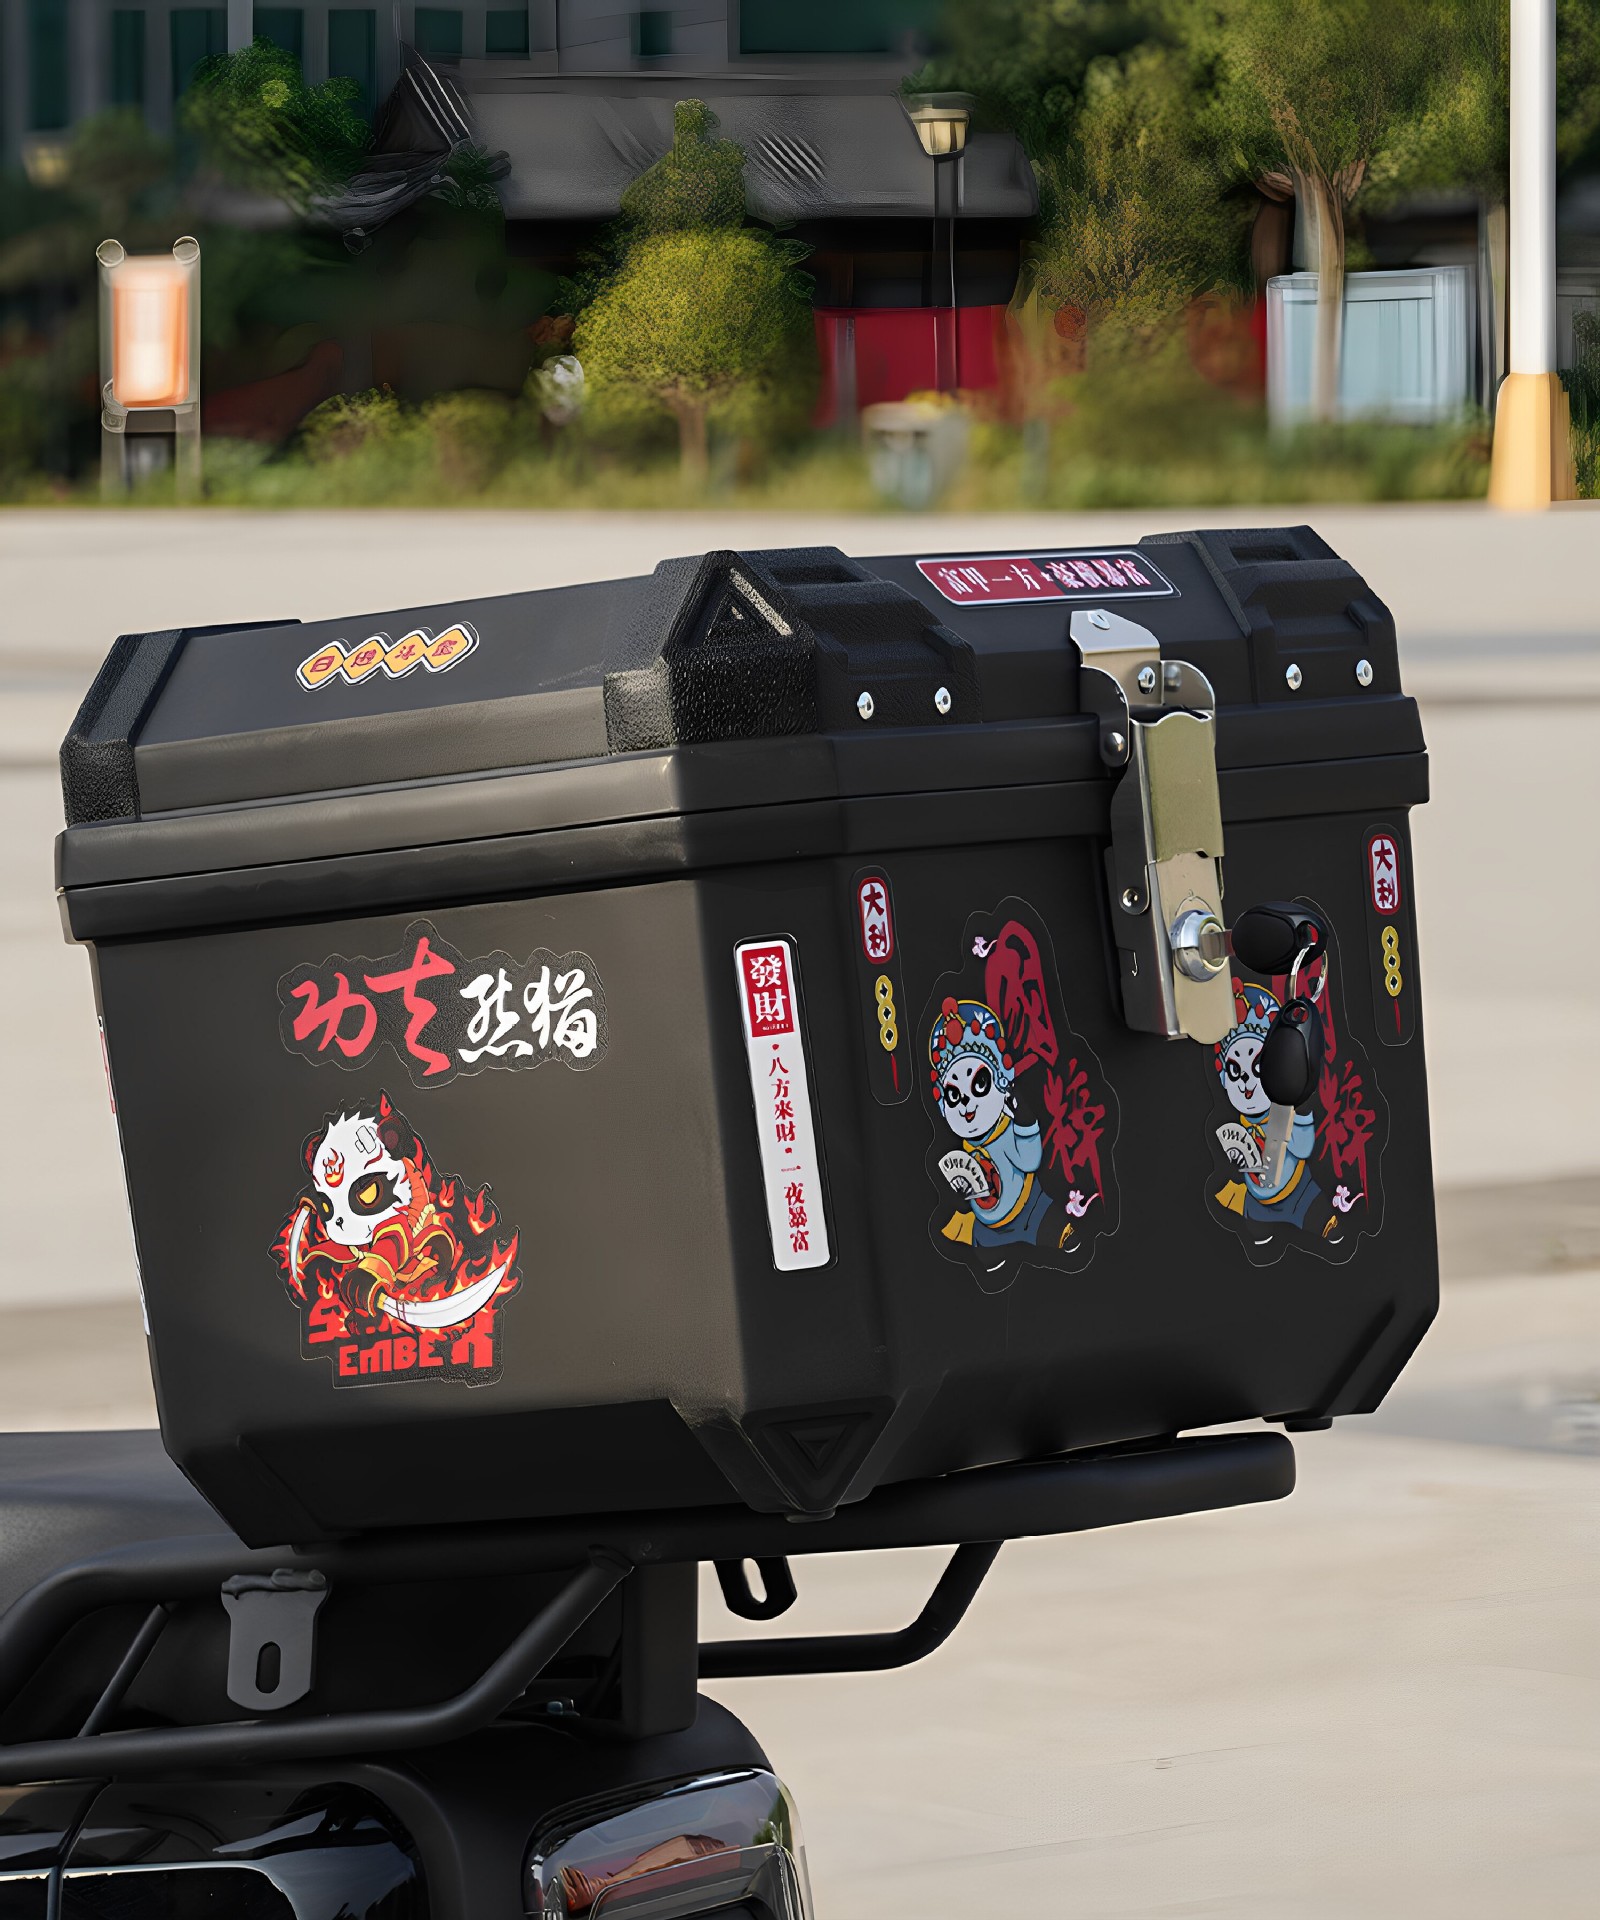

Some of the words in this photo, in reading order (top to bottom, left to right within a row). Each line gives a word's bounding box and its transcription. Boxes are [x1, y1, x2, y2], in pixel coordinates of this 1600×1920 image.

[1374, 838, 1396, 908] 大利
[863, 883, 888, 956] 大利
[749, 954, 788, 1024] 發財
